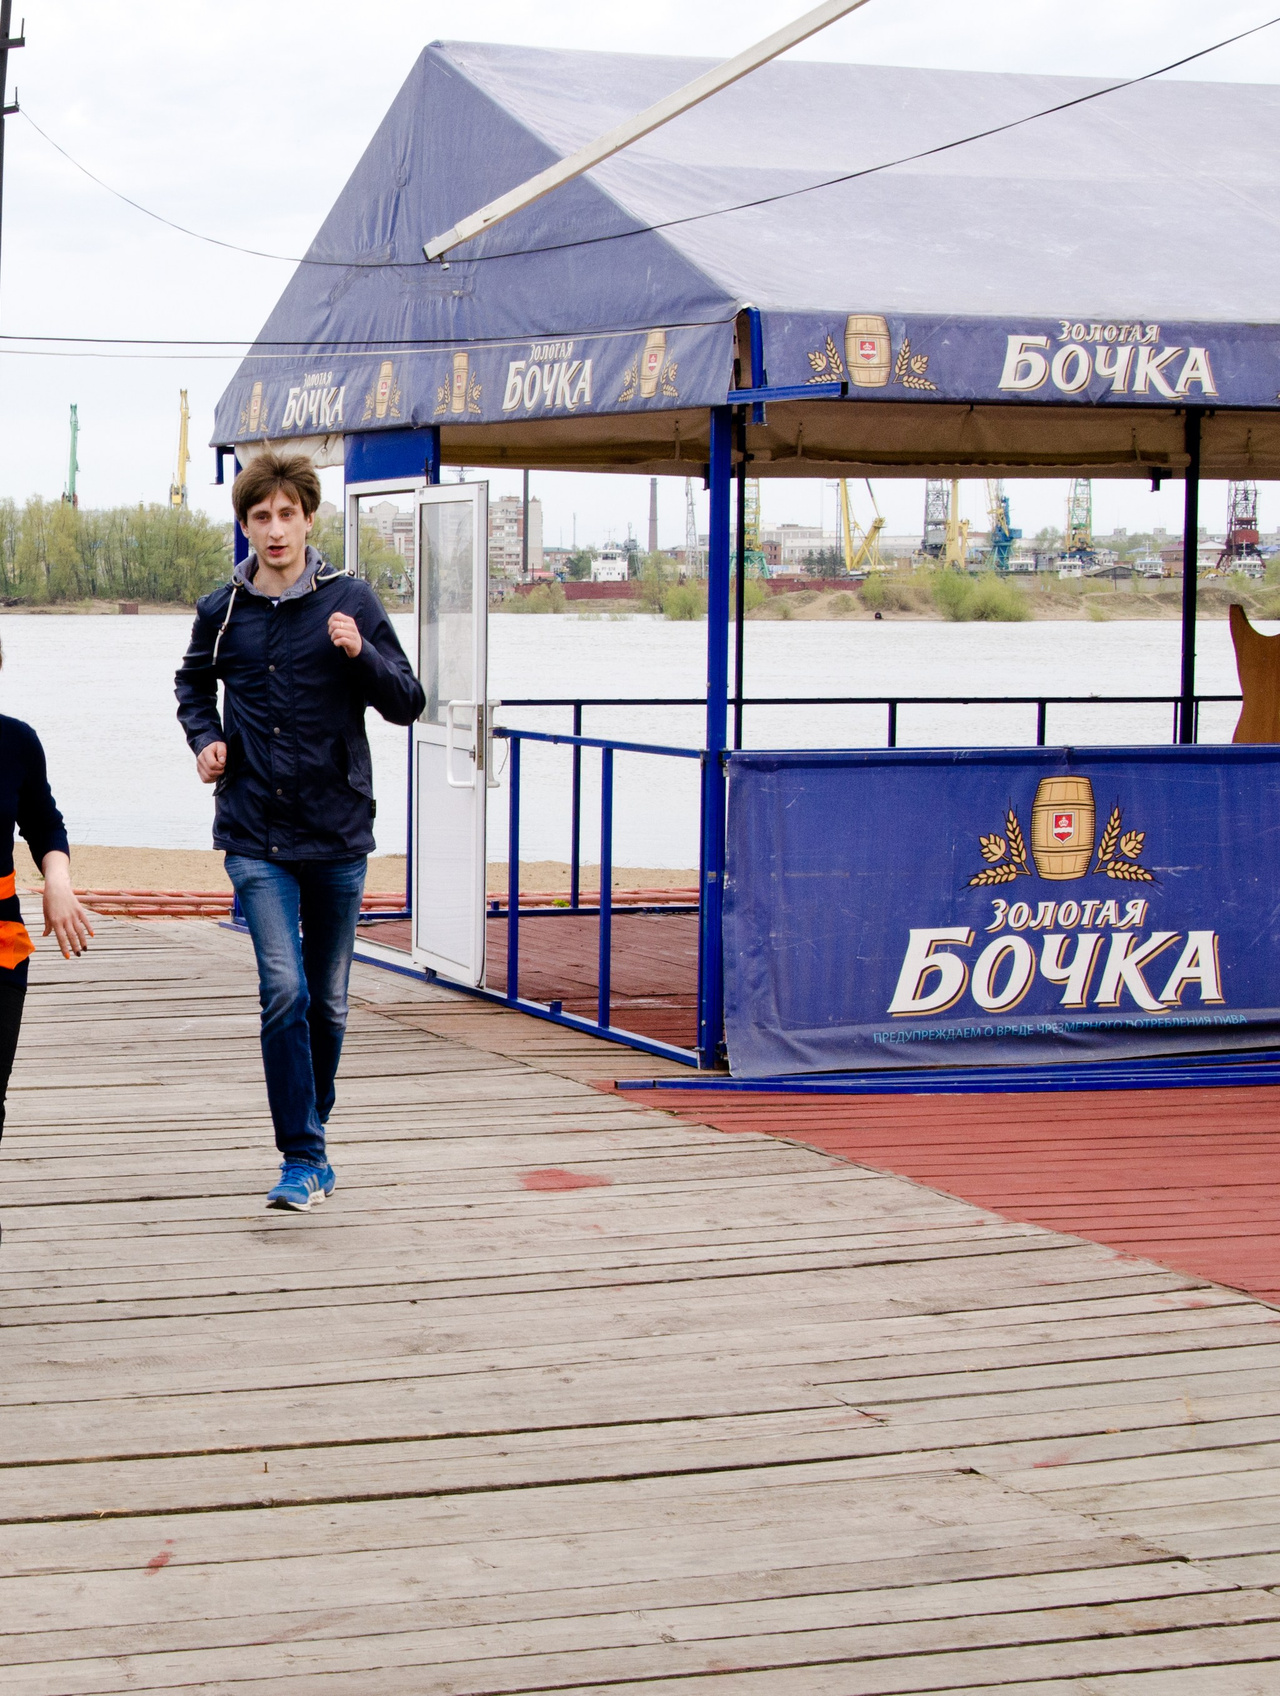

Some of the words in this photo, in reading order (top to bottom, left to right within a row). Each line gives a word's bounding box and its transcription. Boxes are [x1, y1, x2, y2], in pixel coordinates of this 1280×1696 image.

[1058, 320, 1160, 343] ЗОЛОТАЯ
[529, 342, 573, 361] ЗОЛОТАЯ
[998, 335, 1219, 399] БОЧКА
[502, 359, 592, 411] БОЧКА
[282, 386, 346, 429] БОЧКА
[986, 899, 1149, 931] ЗОЛОТАЯ
[887, 927, 1225, 1017] БОЧКА
[873, 1026, 981, 1044] ПРЕДУПРЕЖДАЕМ
[984, 1026, 994, 1037] О
[996, 1024, 1034, 1037] ВРЕДЕ
[1036, 1019, 1123, 1034] ЧРЕЗМЕРНОГО
[1125, 1016, 1211, 1029] ПОТРЕБЛЕНИЯ
[1213, 1014, 1247, 1026] ПИВА
